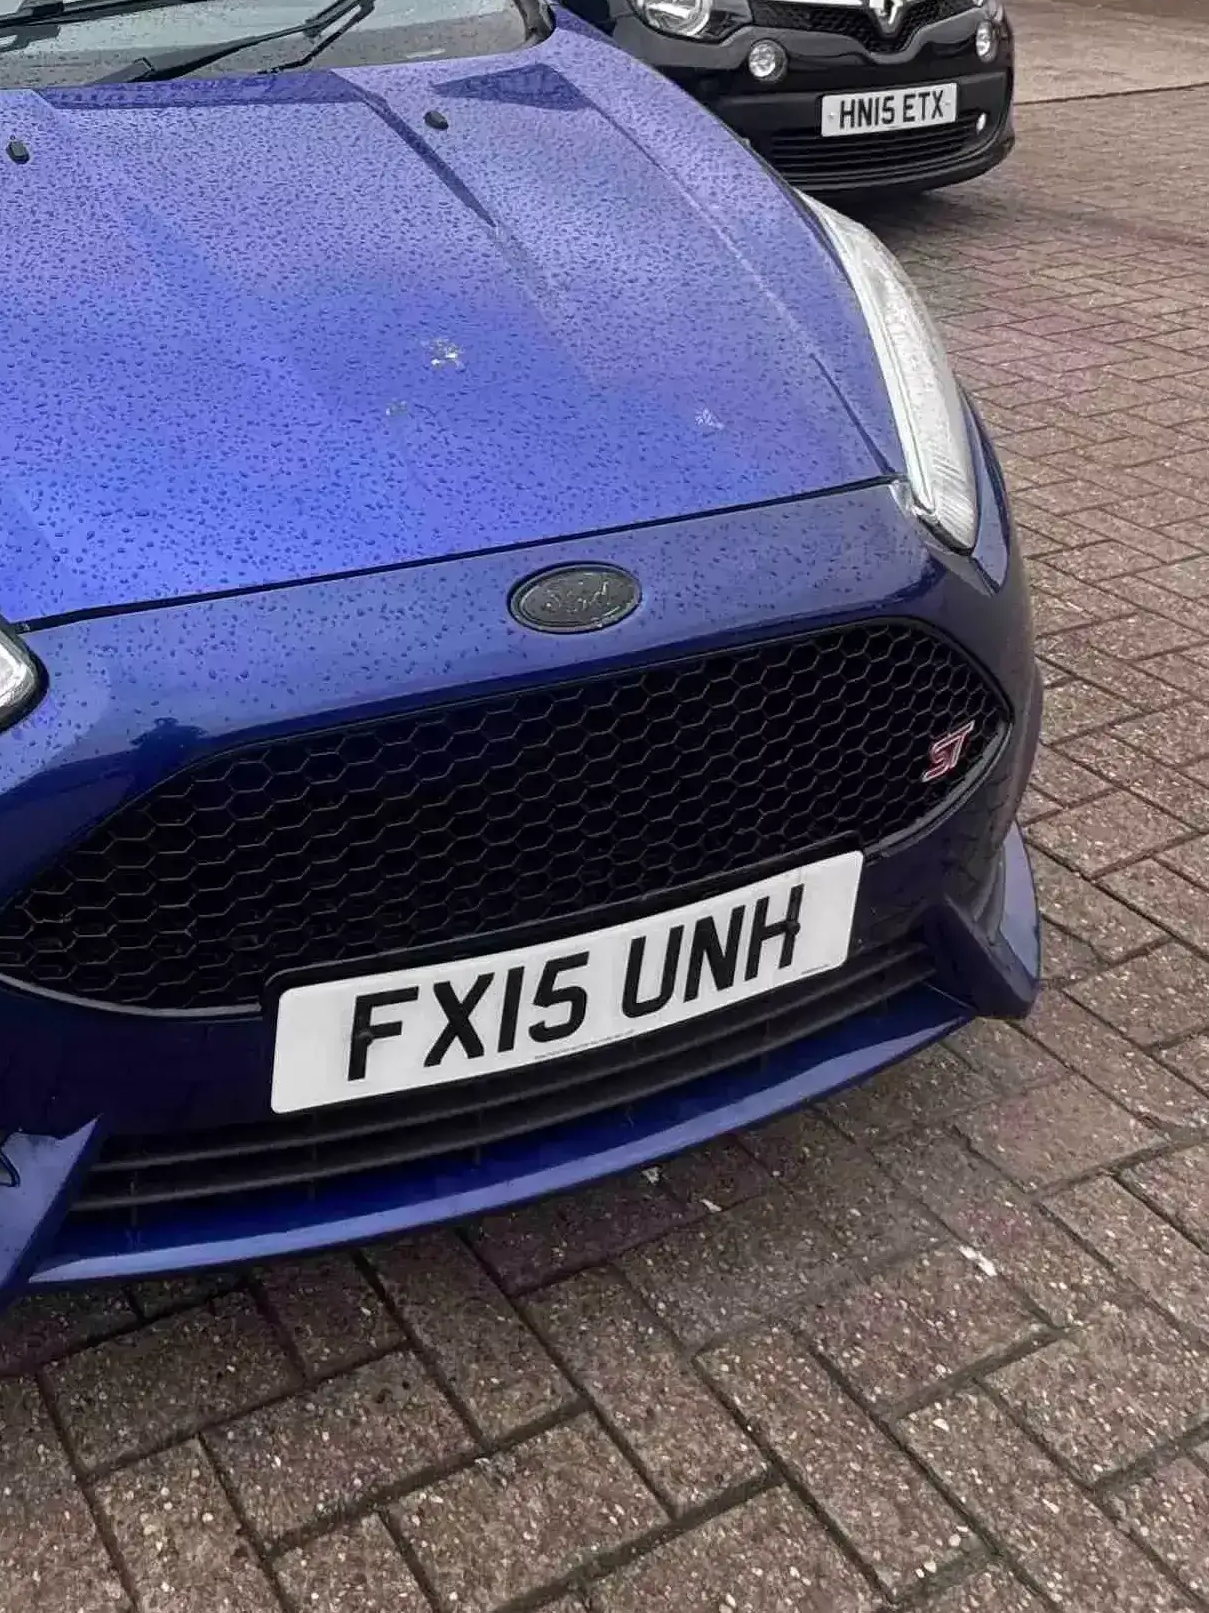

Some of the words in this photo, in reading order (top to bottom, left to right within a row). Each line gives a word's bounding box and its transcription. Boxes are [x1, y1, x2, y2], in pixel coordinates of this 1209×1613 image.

[840, 95, 895, 129] HN15
[903, 90, 943, 122] ETX
[921, 720, 976, 782] ST
[347, 950, 591, 1081] FX15
[621, 884, 805, 1019] UNH
